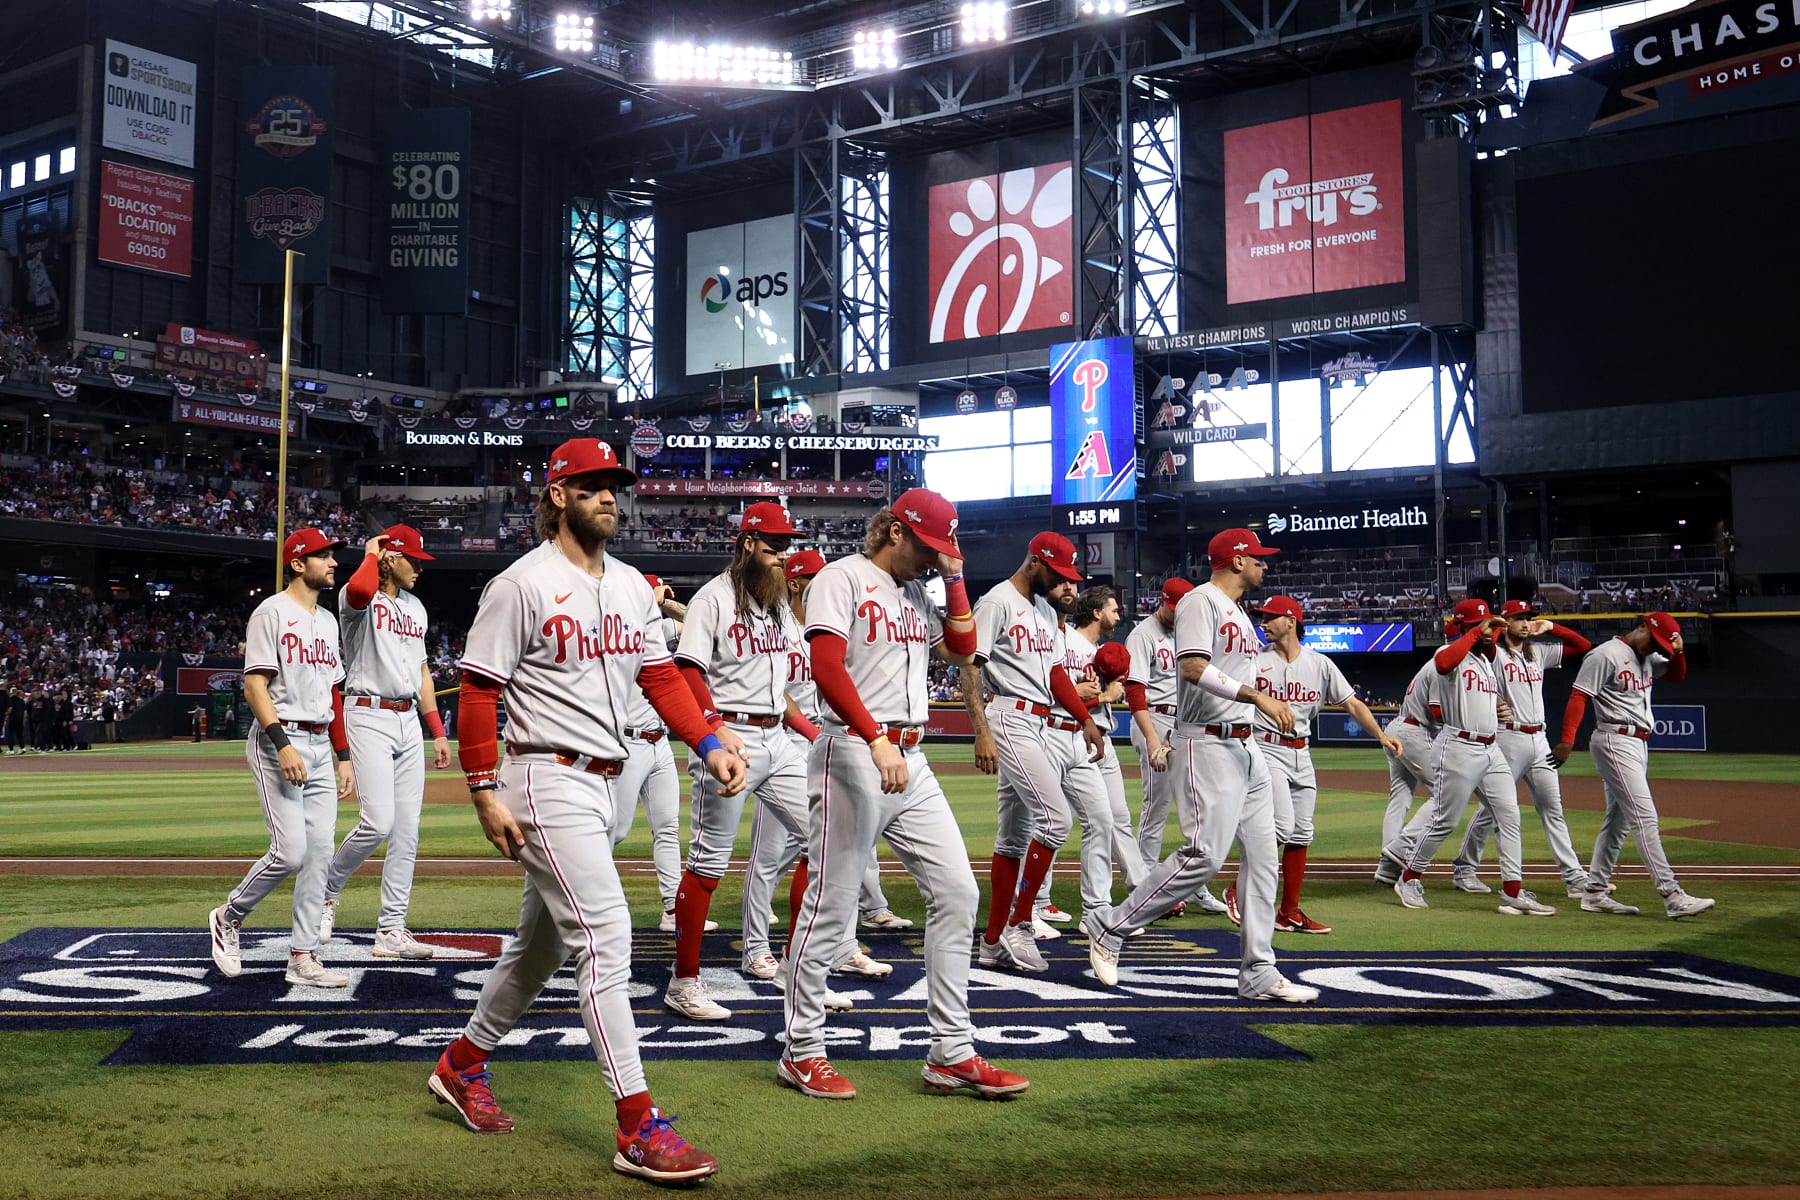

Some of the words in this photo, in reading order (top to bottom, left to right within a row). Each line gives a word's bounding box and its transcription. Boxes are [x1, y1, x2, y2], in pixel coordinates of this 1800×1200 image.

[131, 58, 168, 75] CAESARS
[1700, 63, 1761, 88] HOME
[1780, 53, 1800, 68] O
[131, 68, 193, 96] SPORTSBOOK
[107, 84, 176, 122] DOWNLOAD
[181, 104, 193, 126] IT
[126, 117, 143, 129] USE
[131, 129, 167, 145] DBACKS
[392, 151, 460, 162] CELEBRATING
[107, 164, 134, 178] Report
[135, 171, 157, 184] Guest
[160, 176, 191, 191] Conduct
[392, 164, 460, 200] $80
[1277, 185, 1313, 198] FOOD
[1318, 175, 1369, 192] STORES
[143, 186, 152, 196] by
[155, 187, 182, 203] Texting
[391, 203, 459, 219] MILLION
[118, 213, 177, 236] LOCATION
[253, 217, 281, 235] Give
[278, 218, 313, 237] Back
[418, 221, 431, 232] IN
[125, 230, 139, 239] and
[390, 234, 459, 246] CHARITABLE
[1250, 243, 1285, 258] FRESH
[1288, 240, 1312, 253] FOR
[1317, 230, 1377, 248] EVERYONE
[127, 241, 166, 260] 69050
[390, 248, 459, 267] GIVING
[736, 270, 788, 307] aps
[1291, 317, 1332, 334] WORLD
[1335, 309, 1408, 329] CHAMPIONS
[1147, 340, 1161, 351] NL
[1164, 335, 1195, 350] WEST
[1198, 326, 1266, 347] CHAMPIONS
[162, 345, 266, 375] SANDLOT
[959, 394, 975, 405] JOE
[195, 407, 259, 426] ALL-YOU-CAN-EAT
[467, 431, 481, 445] &
[666, 435, 711, 448] COLD
[715, 435, 771, 449] BEERS
[774, 436, 786, 450] &
[788, 436, 938, 451] CHEESEBURGERS
[1173, 430, 1202, 444] WILD
[1206, 427, 1237, 441] CARD
[598, 442, 612, 460] P
[684, 482, 705, 494] Your
[707, 482, 762, 494] Neighborhood
[763, 482, 794, 495] Burger
[796, 482, 817, 494] Joint
[1068, 510, 1096, 526] 1:55
[1099, 508, 1120, 523] PM
[1289, 514, 1359, 532] Banner
[1362, 506, 1428, 529] Health
[373, 603, 424, 640] Phillie
[857, 600, 928, 644] Phillie
[1305, 626, 1363, 636] LADELPHIA
[727, 622, 789, 658] Phillie
[1009, 624, 1054, 654] Phillie
